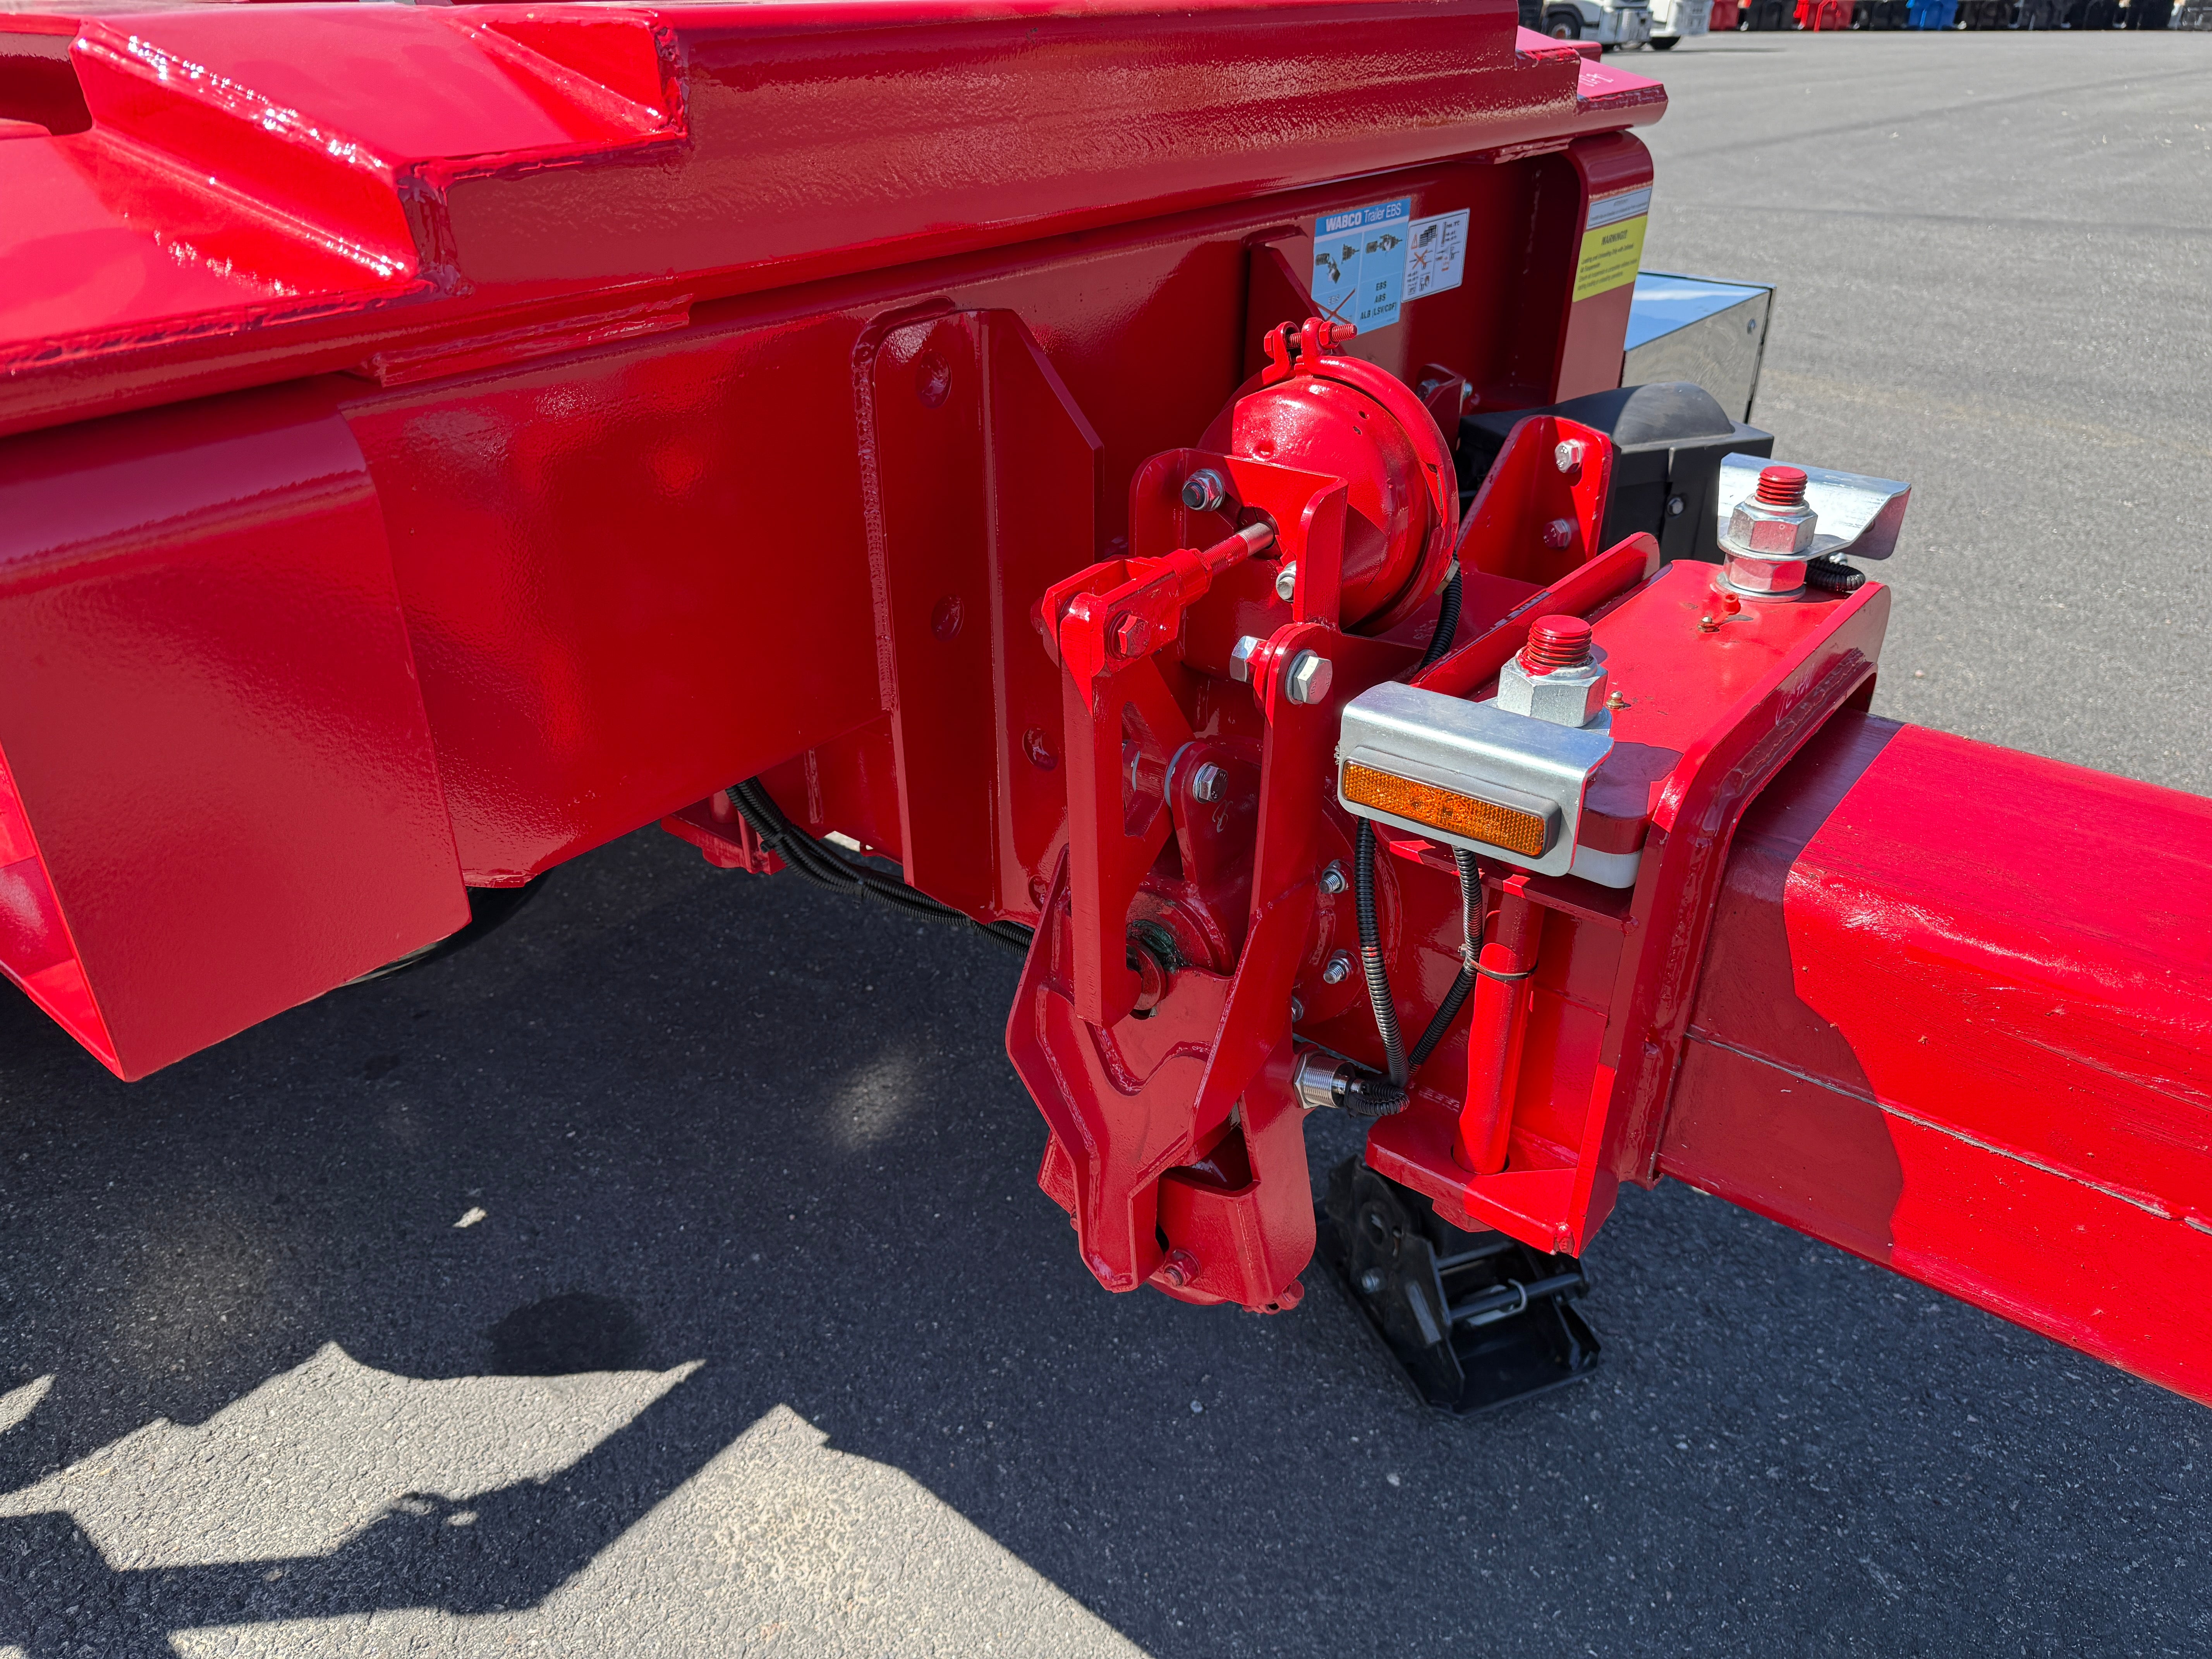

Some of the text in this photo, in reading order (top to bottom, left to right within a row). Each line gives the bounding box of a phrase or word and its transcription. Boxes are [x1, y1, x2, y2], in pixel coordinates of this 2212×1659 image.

[1326, 203, 1401, 232] WABCO Trailer EBS
[1376, 281, 1386, 291] EBS
[1374, 294, 1386, 303] ABS
